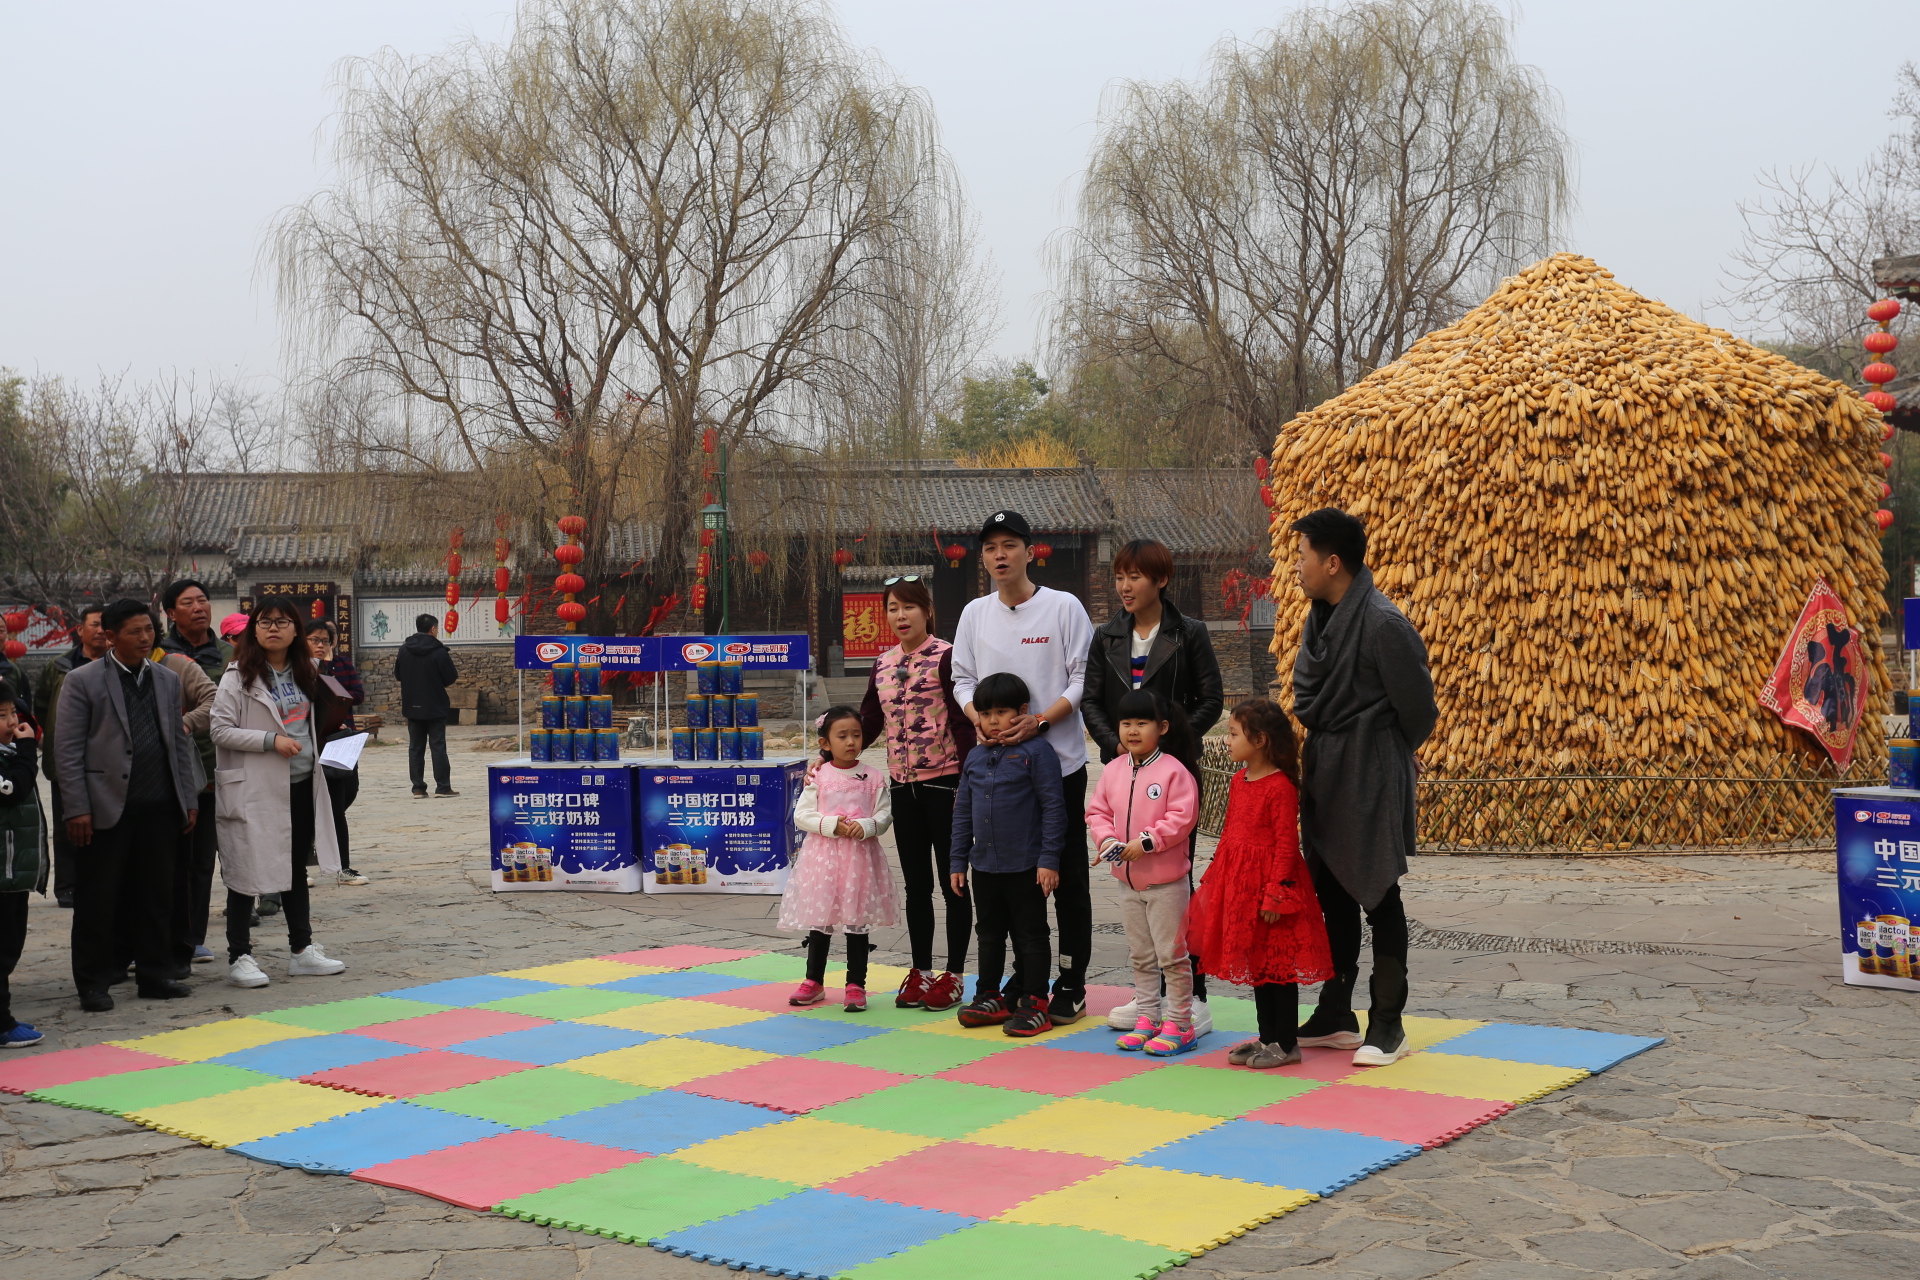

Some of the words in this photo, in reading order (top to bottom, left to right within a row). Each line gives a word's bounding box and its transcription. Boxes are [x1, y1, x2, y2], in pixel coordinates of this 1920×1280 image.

[263, 583, 328, 594] 文武財神
[843, 607, 879, 643] 福
[606, 645, 641, 655] 三元奶粉
[753, 644, 788, 654] 三元奶粉
[513, 793, 600, 807] 中国好口碑
[667, 793, 755, 808] 中国好口碑
[514, 811, 600, 825] 三元好奶粉
[668, 811, 756, 826] 三元好奶粉
[1874, 838, 1920, 863] 中国
[1876, 867, 1920, 890] 三元
[1878, 926, 1906, 936] ilactou
